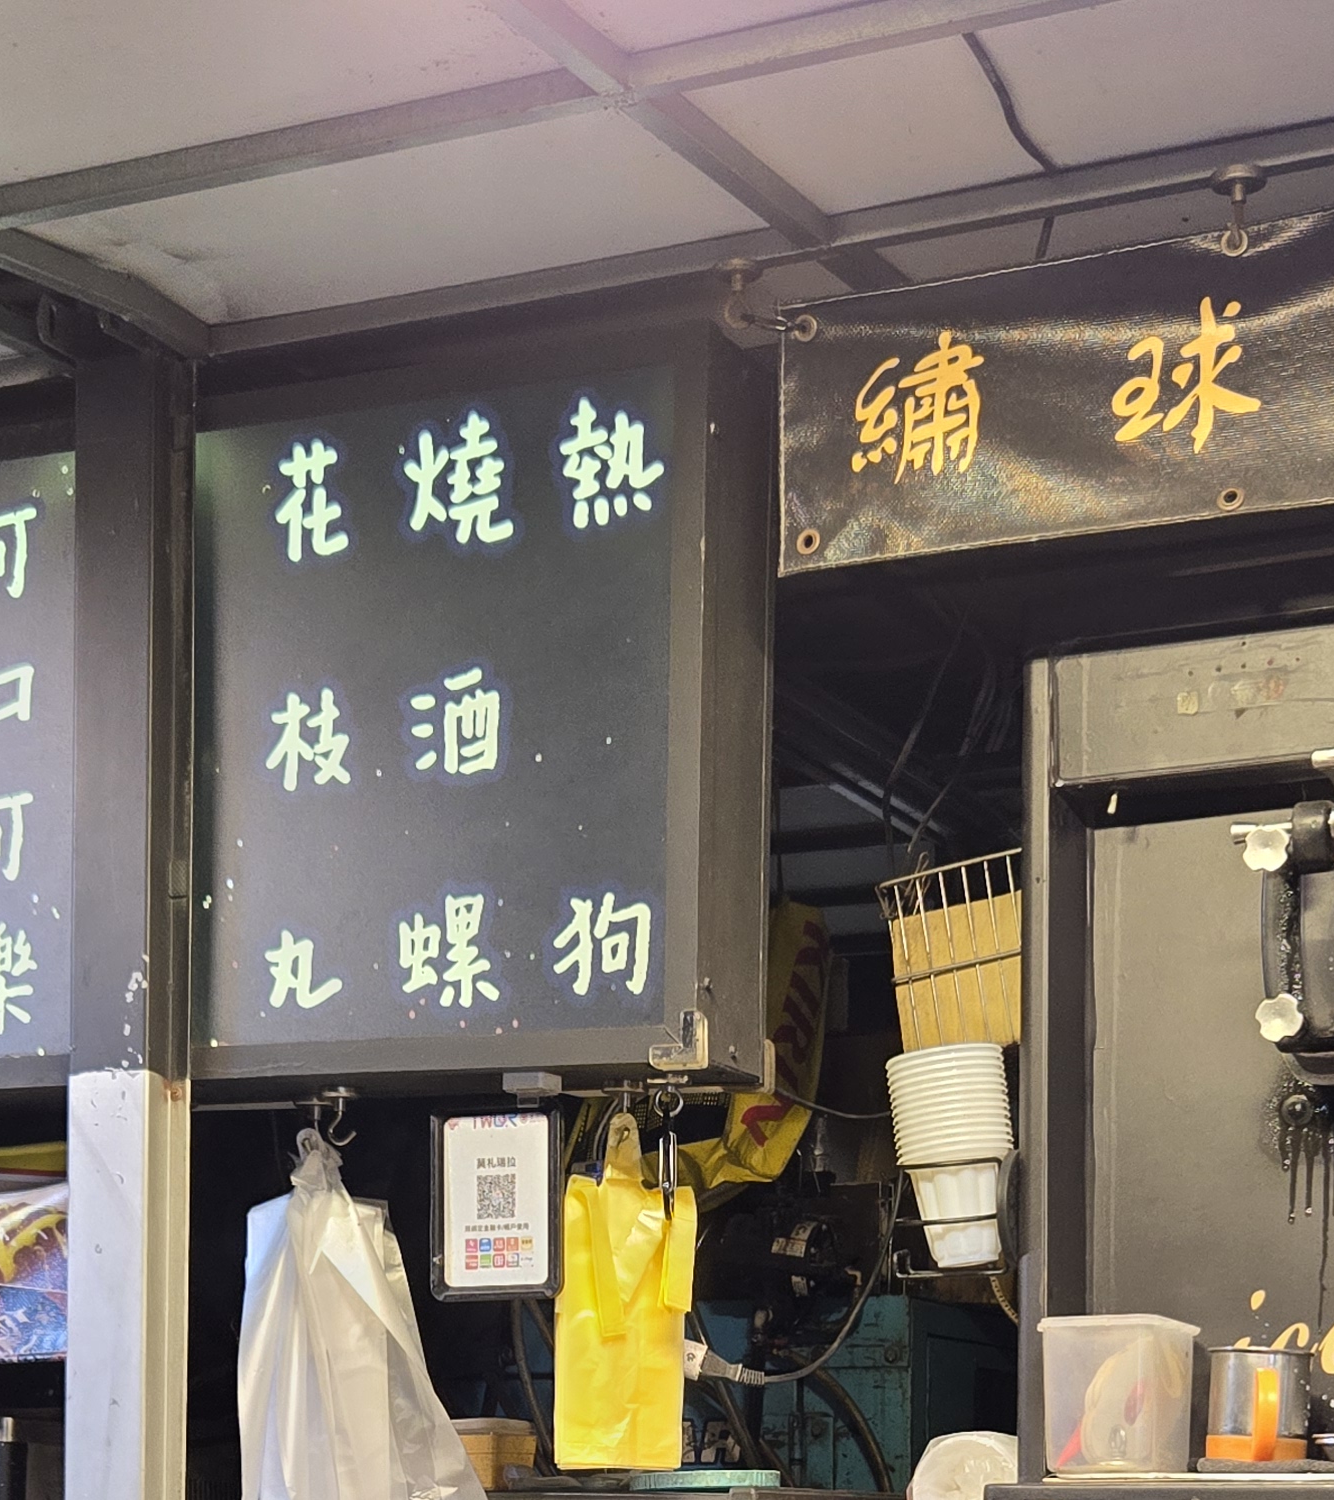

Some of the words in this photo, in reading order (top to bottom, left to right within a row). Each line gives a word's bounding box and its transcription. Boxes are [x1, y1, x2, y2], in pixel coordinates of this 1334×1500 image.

[266, 438, 351, 1008] 花枝丸
[398, 410, 514, 1008] 燒酒螺
[553, 397, 665, 996] 熱狗
